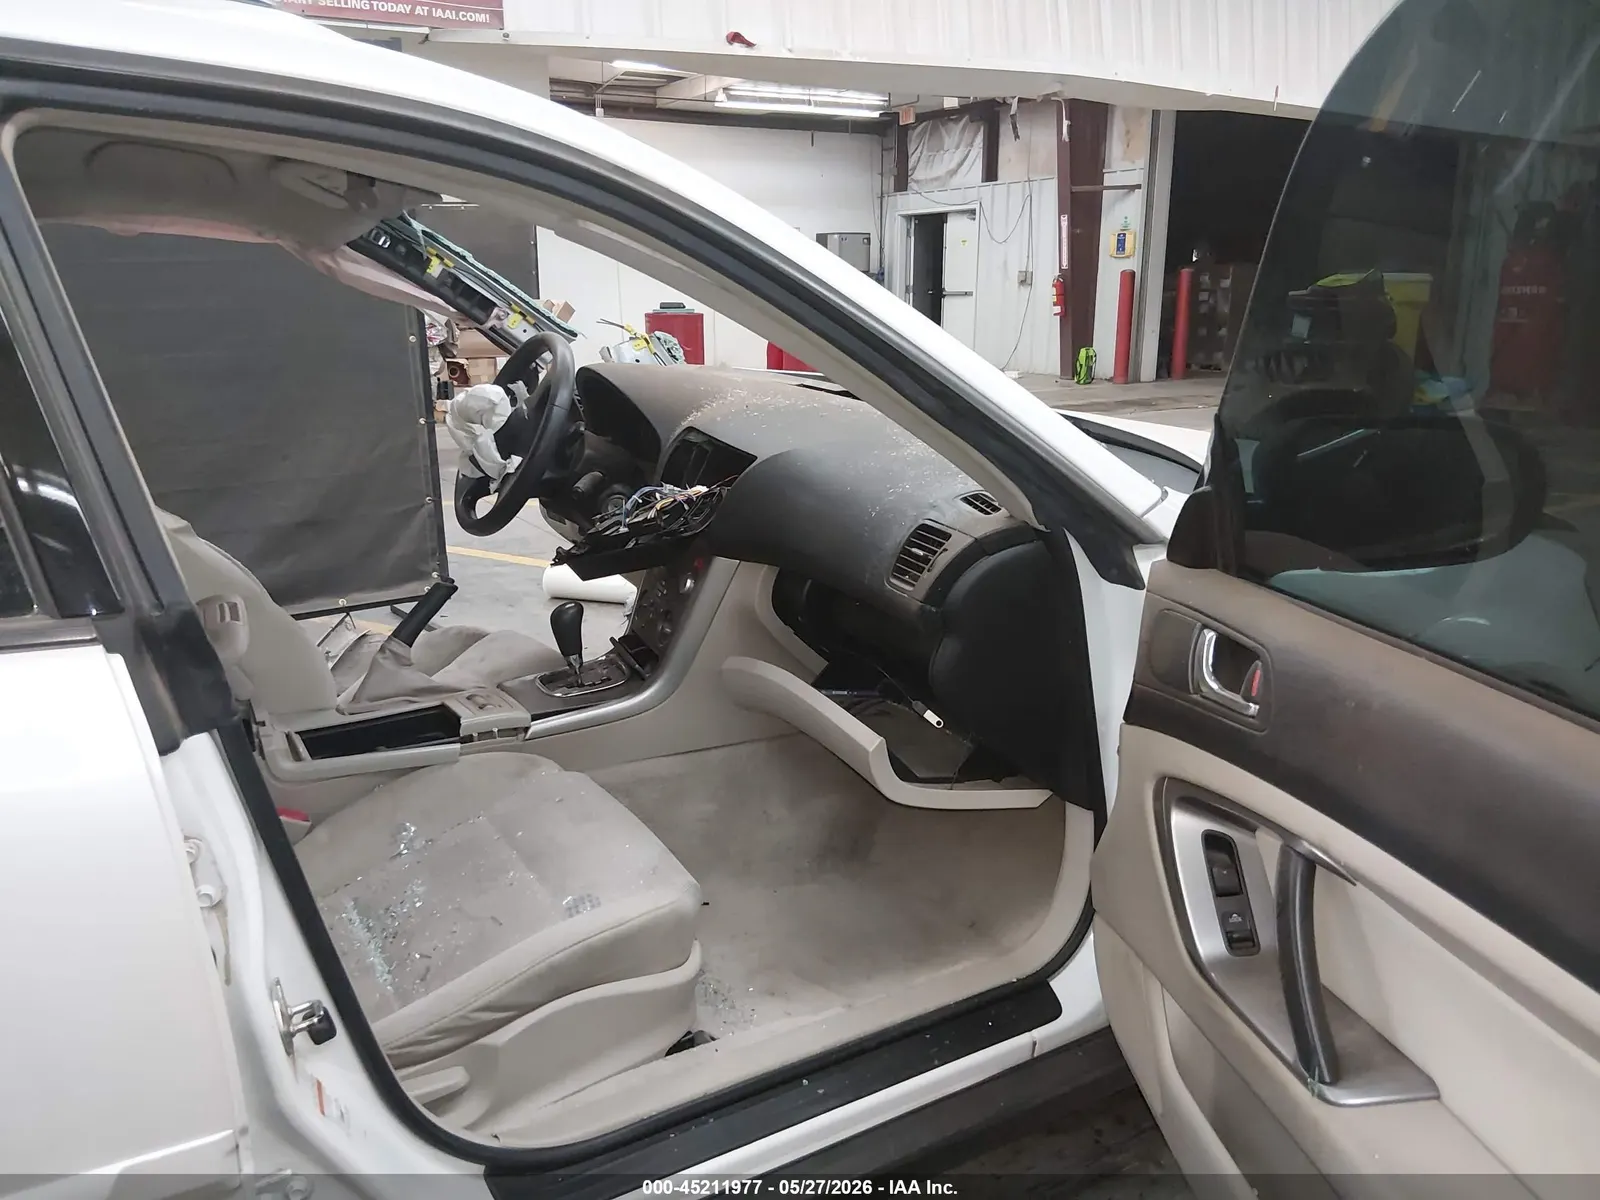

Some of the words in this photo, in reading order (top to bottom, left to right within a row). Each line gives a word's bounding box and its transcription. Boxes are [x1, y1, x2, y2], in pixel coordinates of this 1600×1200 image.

[318, 0, 370, 9] SELLING
[371, 1, 412, 14] TODAY
[414, 6, 429, 16] AT
[432, 7, 490, 23] IAAI.COM!
